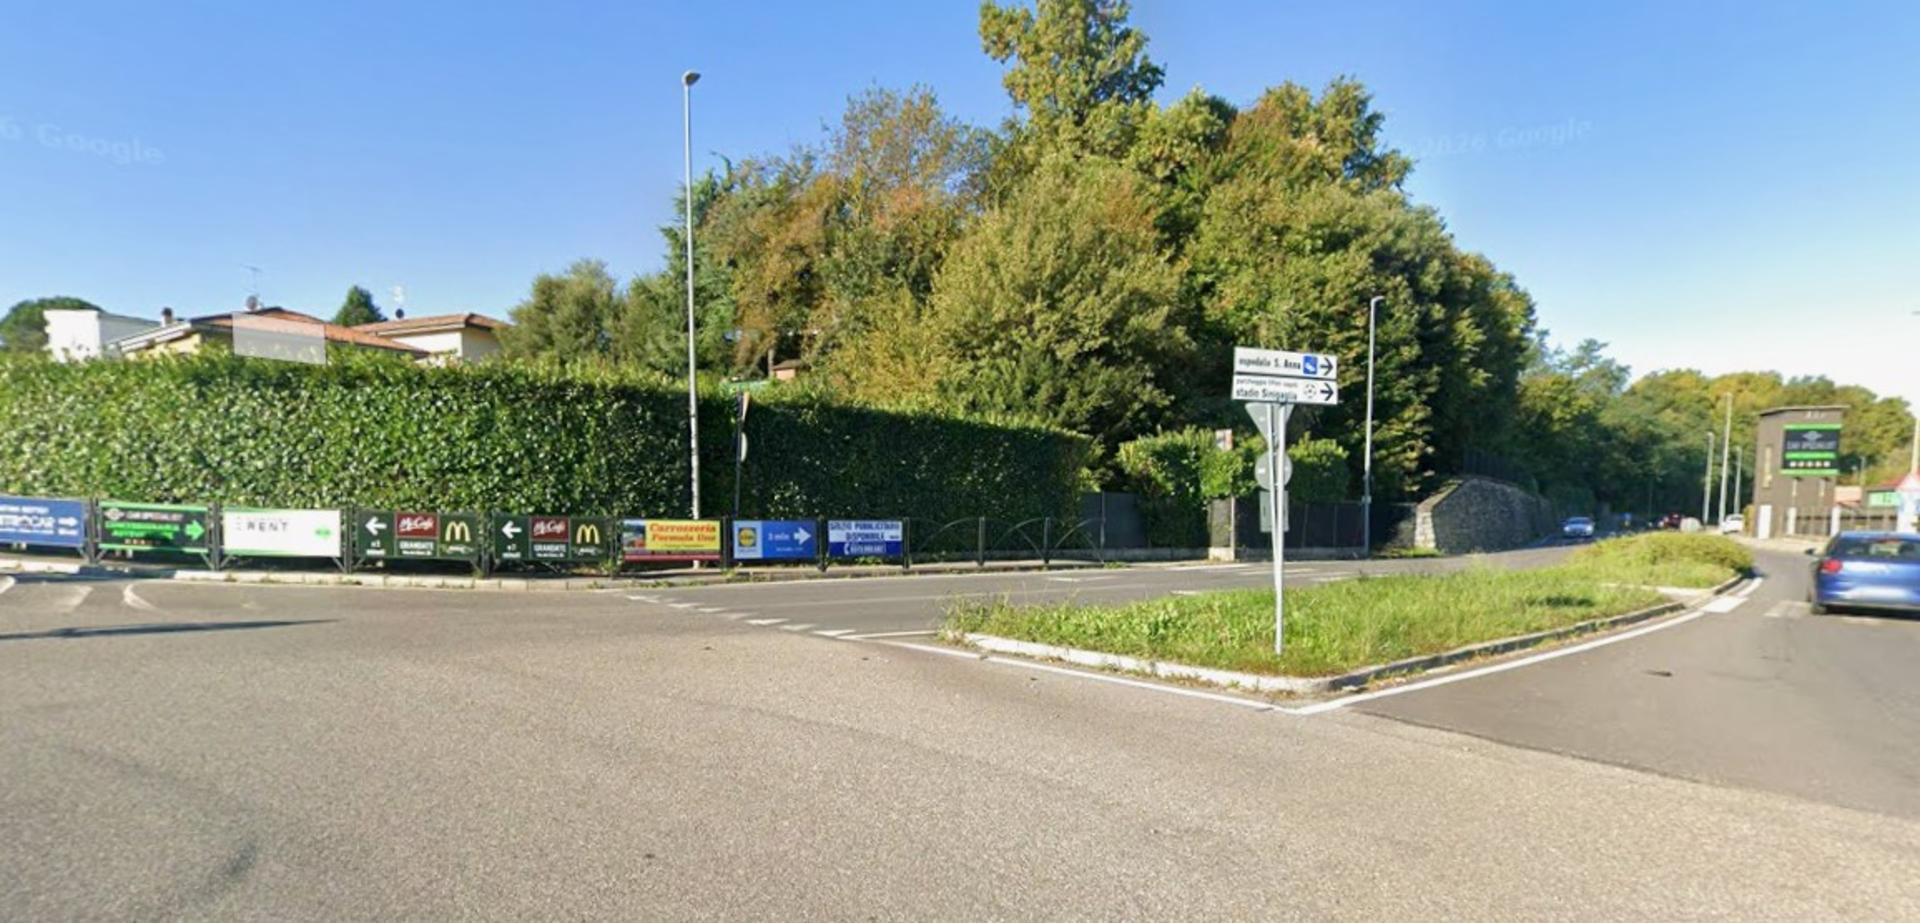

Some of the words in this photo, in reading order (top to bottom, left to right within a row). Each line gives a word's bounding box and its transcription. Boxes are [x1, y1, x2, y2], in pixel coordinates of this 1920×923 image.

[1239, 356, 1271, 368] ospedale
[1274, 359, 1281, 368] S.
[1284, 359, 1301, 370] Anna
[1236, 388, 1259, 398] stadio
